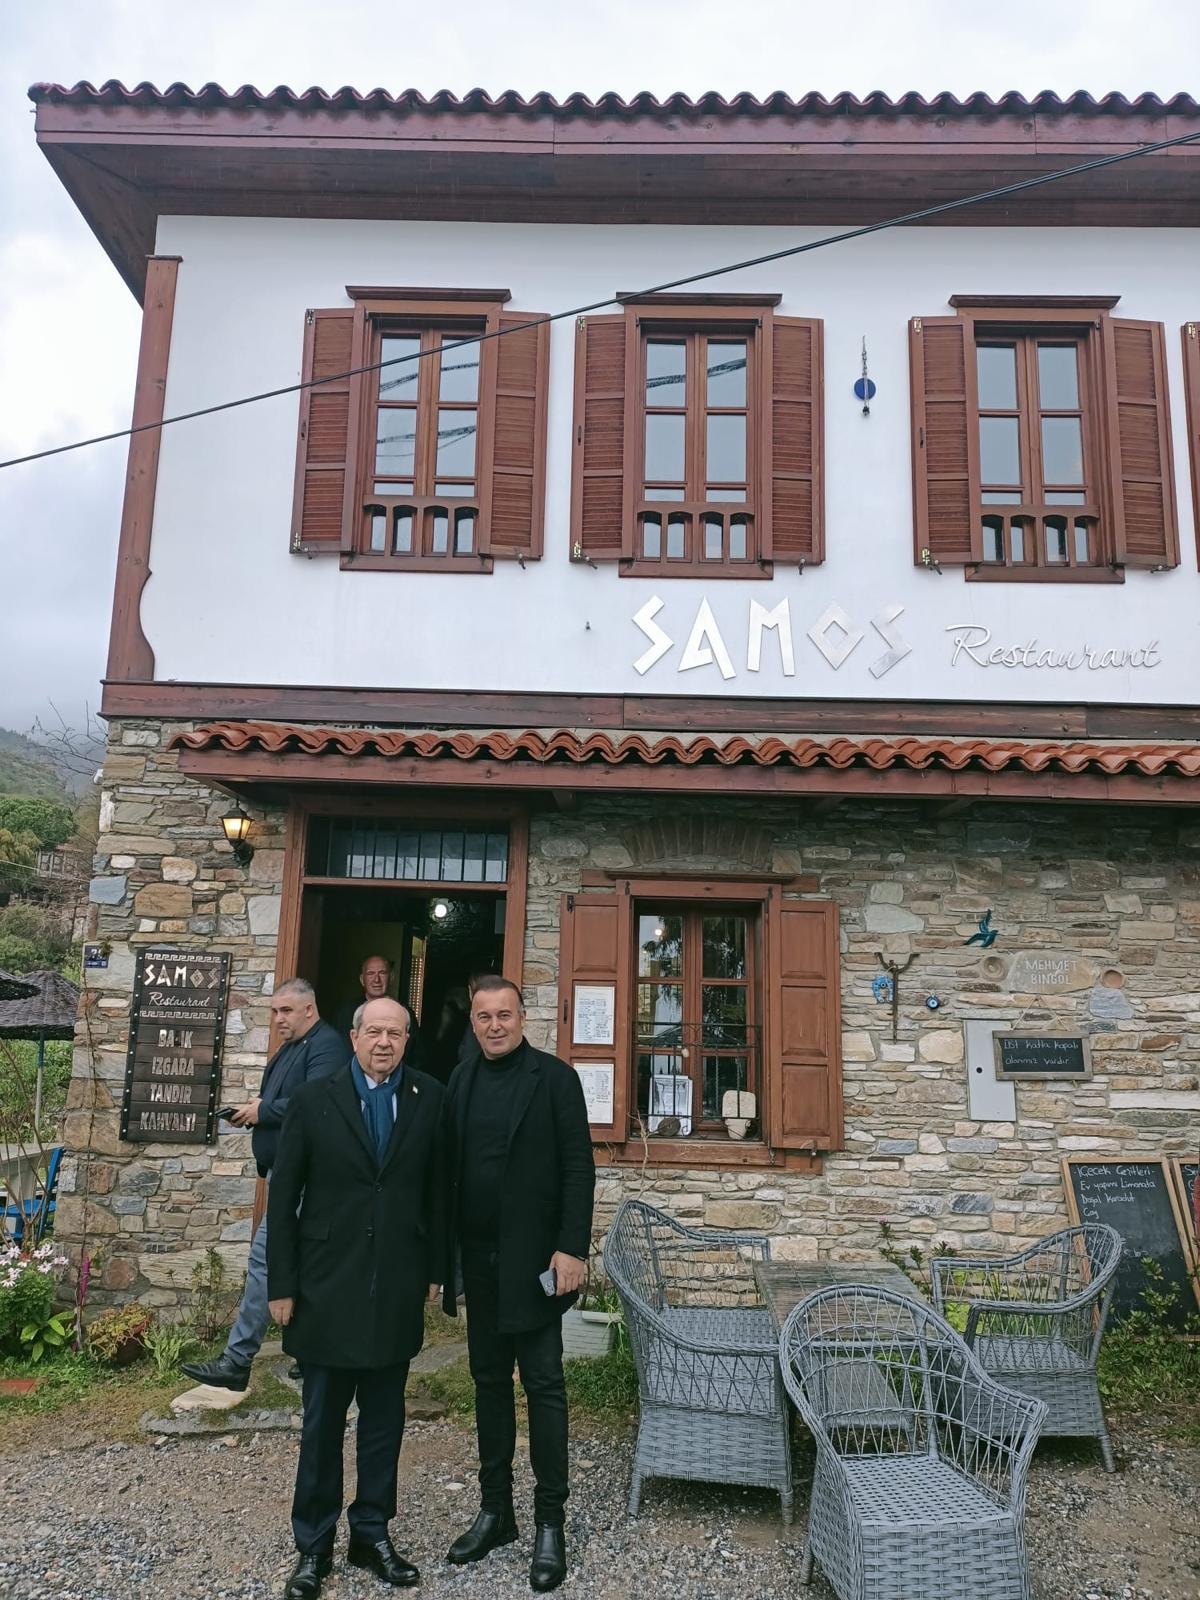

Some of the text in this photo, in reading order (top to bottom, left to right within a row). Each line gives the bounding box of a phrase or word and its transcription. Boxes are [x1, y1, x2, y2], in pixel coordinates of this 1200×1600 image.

[631, 594, 1162, 680] SAMOS Restaurant
[1025, 959, 1078, 971] MEHMET
[144, 963, 219, 989] SAMOS
[148, 991, 211, 1007] Restaurant
[158, 1029, 194, 1049] BAIK
[151, 1056, 195, 1076] IZGARA
[150, 1083, 193, 1104] TANDIR
[140, 1111, 197, 1132] KAHVALTI
